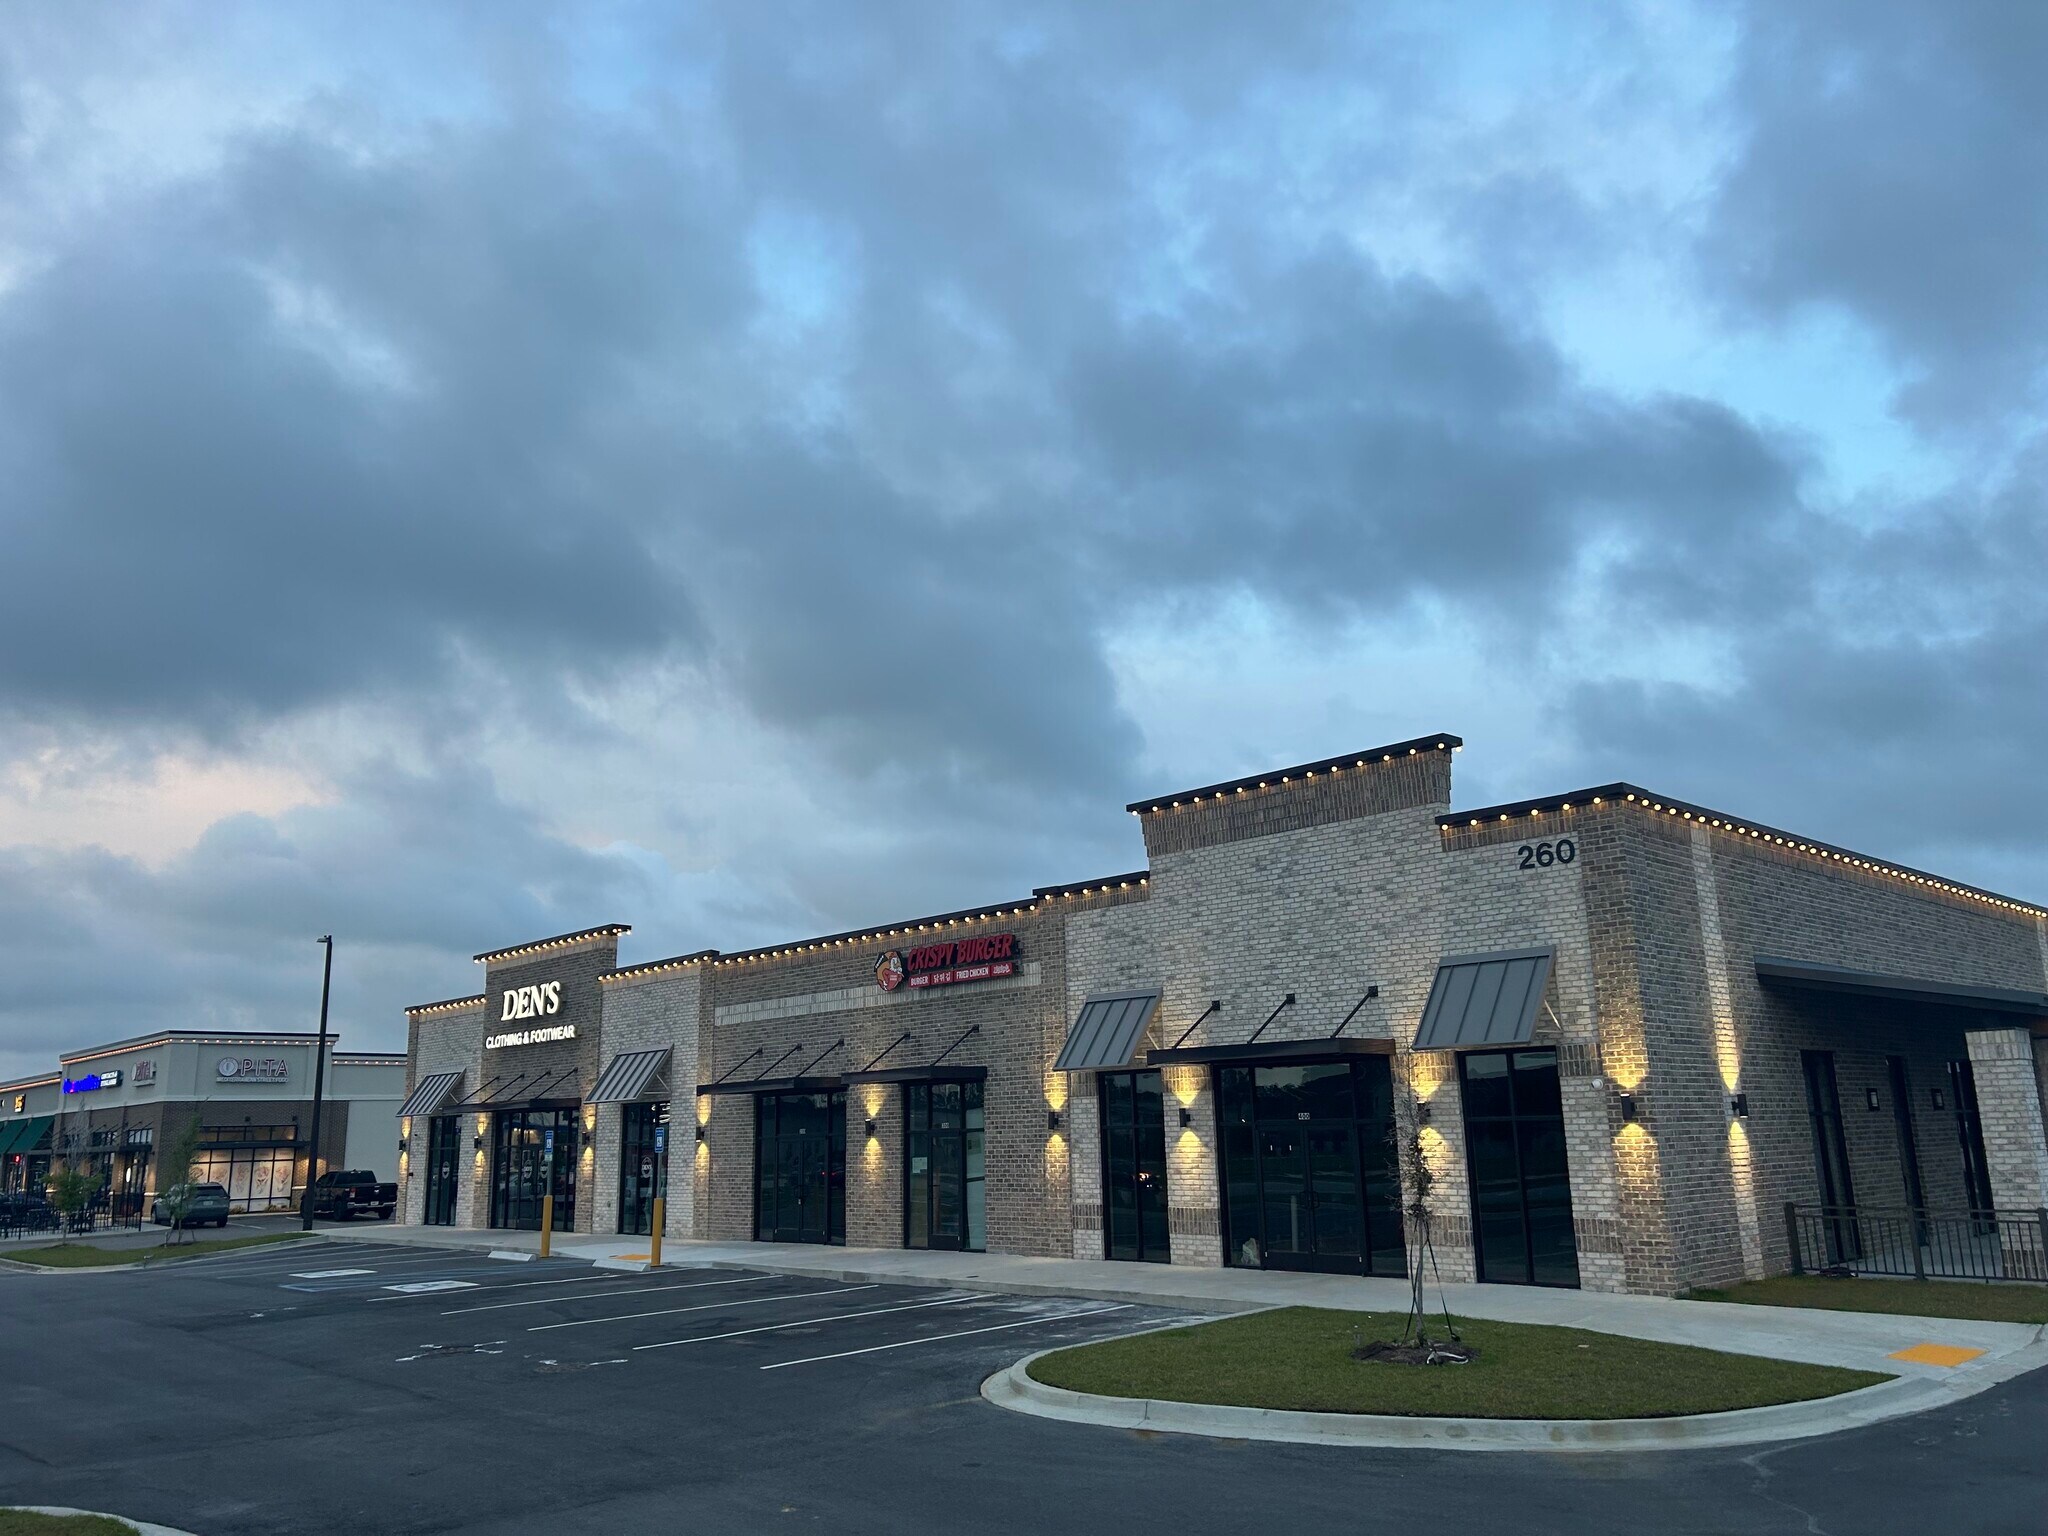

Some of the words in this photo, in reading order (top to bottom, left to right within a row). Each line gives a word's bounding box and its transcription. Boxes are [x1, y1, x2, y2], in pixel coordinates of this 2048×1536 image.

[1517, 839, 1576, 870] 260
[908, 944, 954, 971] CRISPY
[957, 934, 1013, 963] BURGER
[956, 970, 969, 980] FRIED
[969, 967, 988, 977] CHICKEN
[500, 980, 561, 1021] DEN'S
[485, 1032, 522, 1050] CLOTHING
[522, 1031, 530, 1044] &
[530, 1024, 576, 1043] FOOTWEAR
[240, 1058, 289, 1077] PITA
